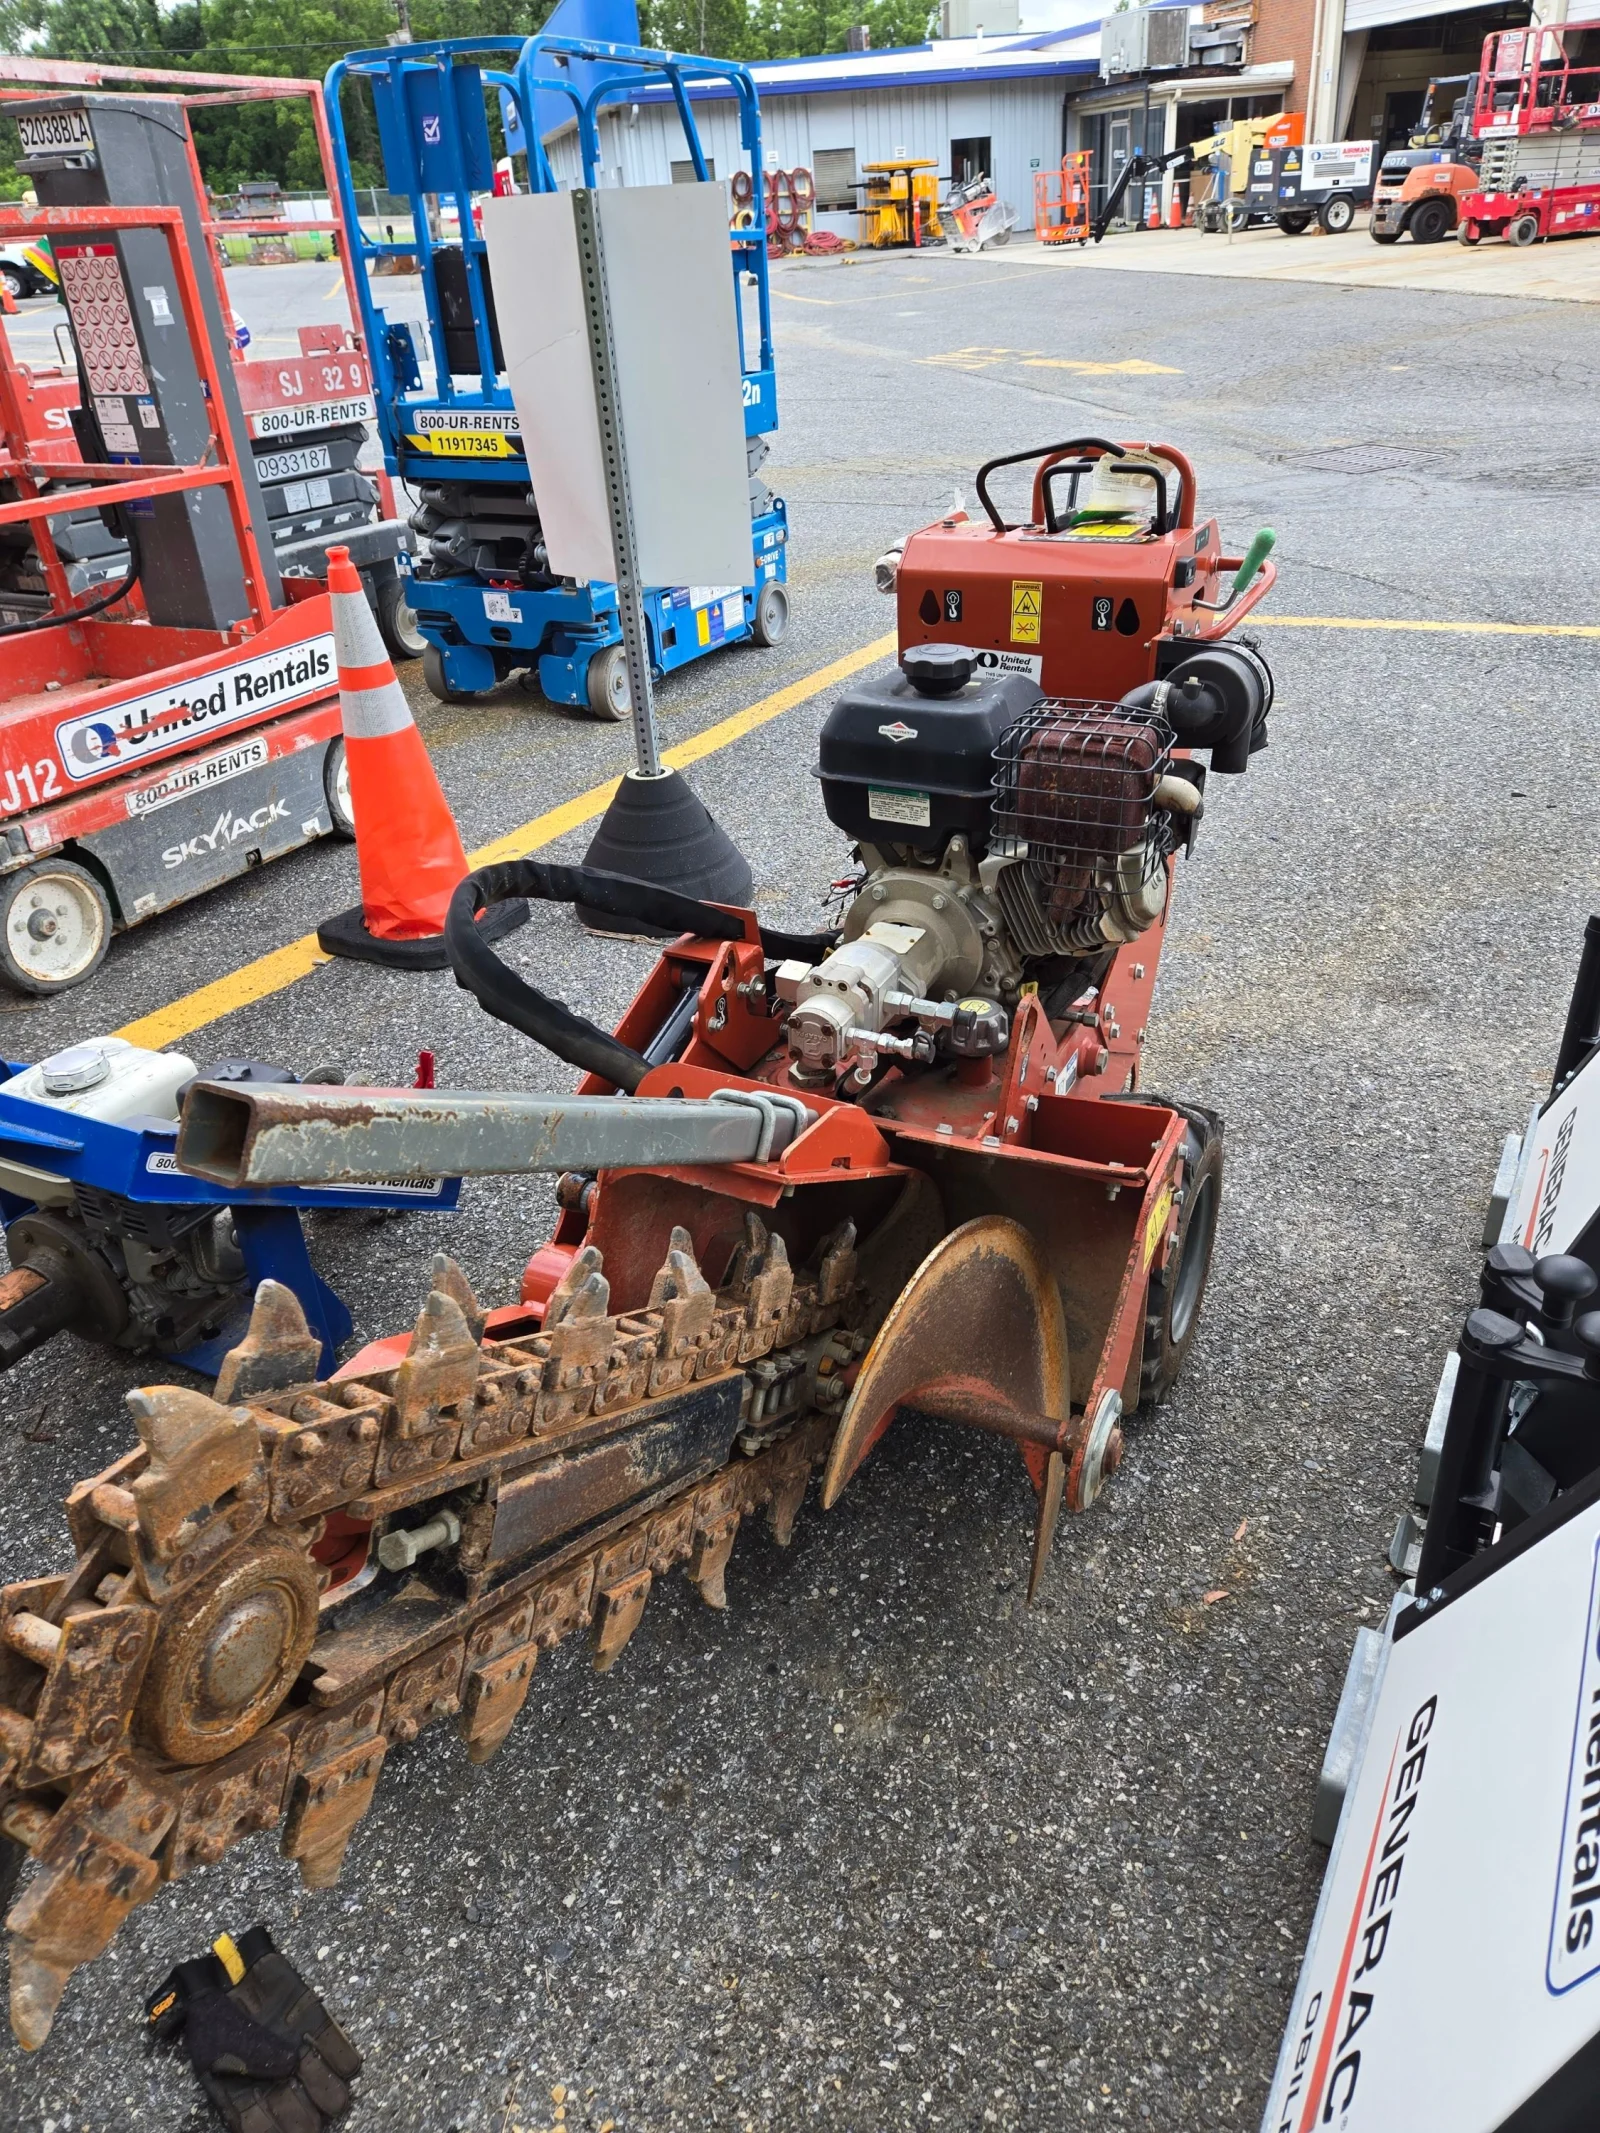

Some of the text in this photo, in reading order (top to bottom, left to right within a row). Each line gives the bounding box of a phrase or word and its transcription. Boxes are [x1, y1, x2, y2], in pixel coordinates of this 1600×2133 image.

[17, 113, 91, 147] 52038BLA
[1211, 138, 1226, 149] JLG
[1065, 227, 1081, 236] JLG
[279, 370, 303, 397] SJ
[262, 401, 367, 432] 800-UR-RENTS
[420, 416, 520, 430] 800-UR-RENTS
[438, 437, 498, 452] 11917345
[257, 447, 328, 479] 0933187
[1000, 662, 1033, 674] Rentals
[1001, 654, 1031, 666] United
[233, 649, 330, 707] Rentals
[162, 798, 292, 870] SKYJACK
[1533, 1106, 1578, 1256] GENERAC
[1322, 1694, 1438, 2125] GENERAC
